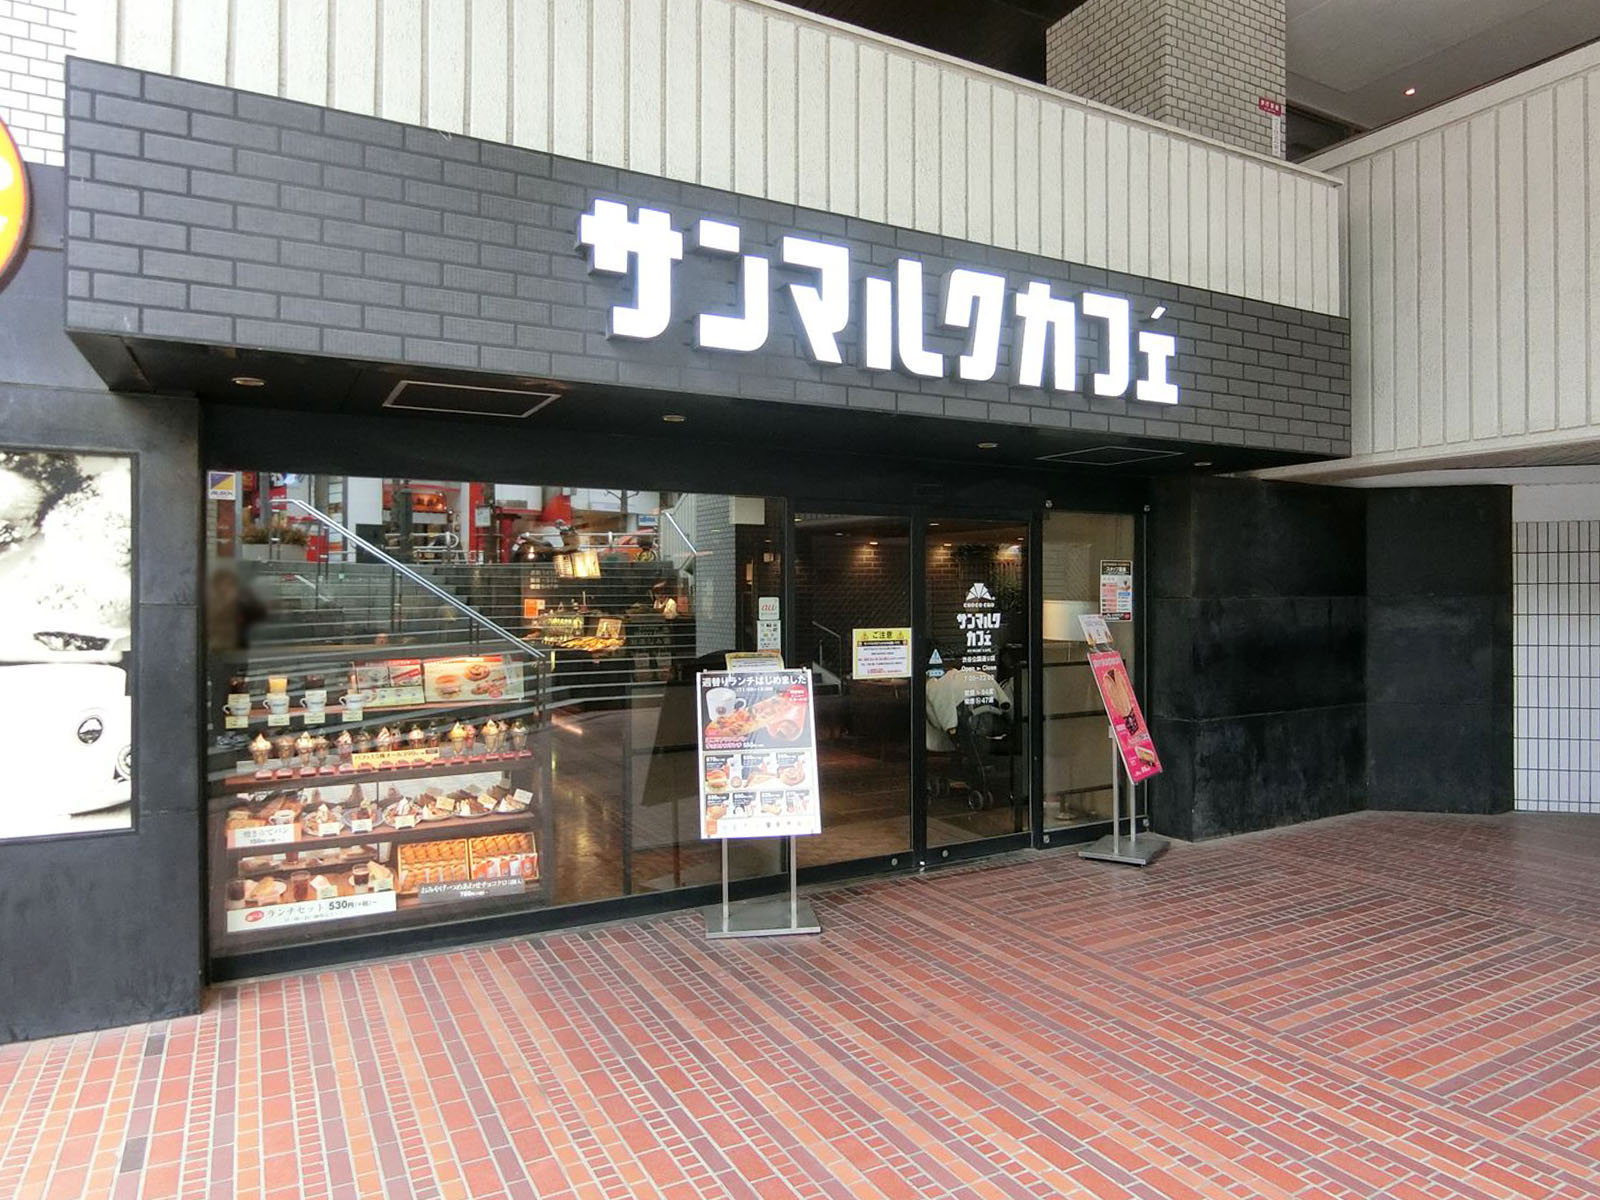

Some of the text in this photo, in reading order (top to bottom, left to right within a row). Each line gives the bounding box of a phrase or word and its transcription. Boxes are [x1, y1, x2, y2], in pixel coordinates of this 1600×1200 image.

[956, 612, 1001, 629] サンマルク
